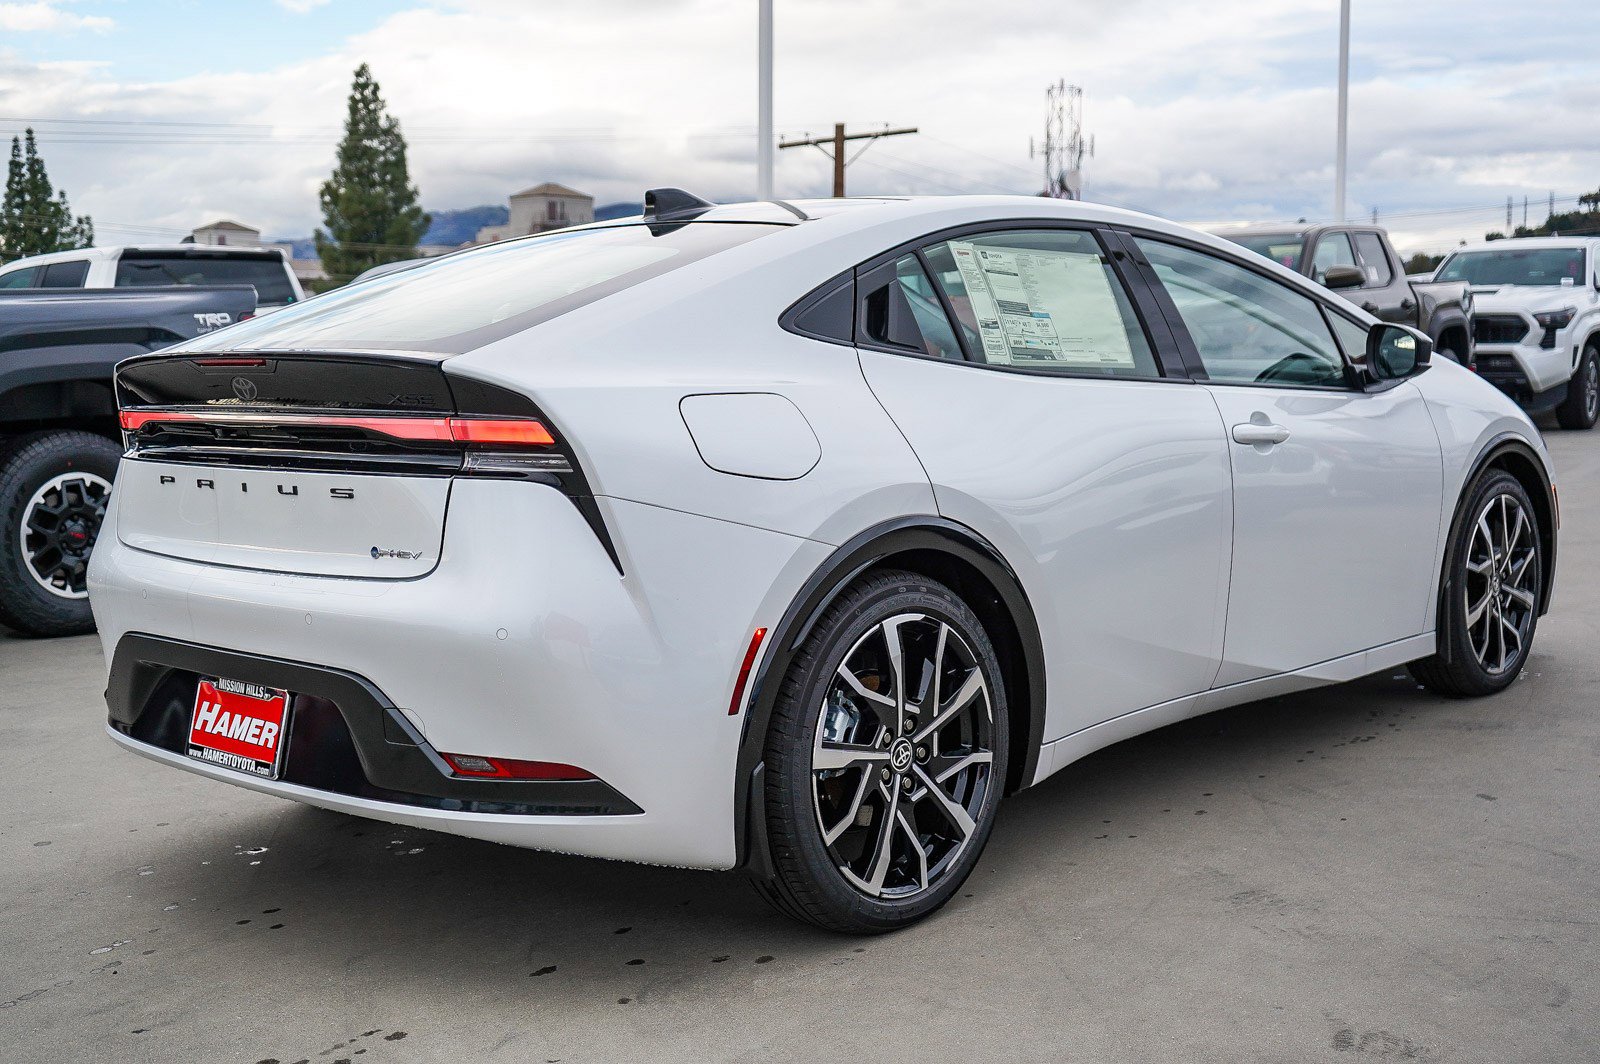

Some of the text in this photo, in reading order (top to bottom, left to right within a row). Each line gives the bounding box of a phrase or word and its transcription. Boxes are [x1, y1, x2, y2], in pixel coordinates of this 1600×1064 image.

[193, 312, 231, 328] TRD
[388, 393, 435, 405] XSE
[160, 475, 354, 499] PRIUS
[219, 678, 245, 694] MISSION
[245, 683, 264, 698] HILLS
[194, 700, 279, 749] HAMER
[188, 747, 270, 776] www.HAMERTOYOTA.com
